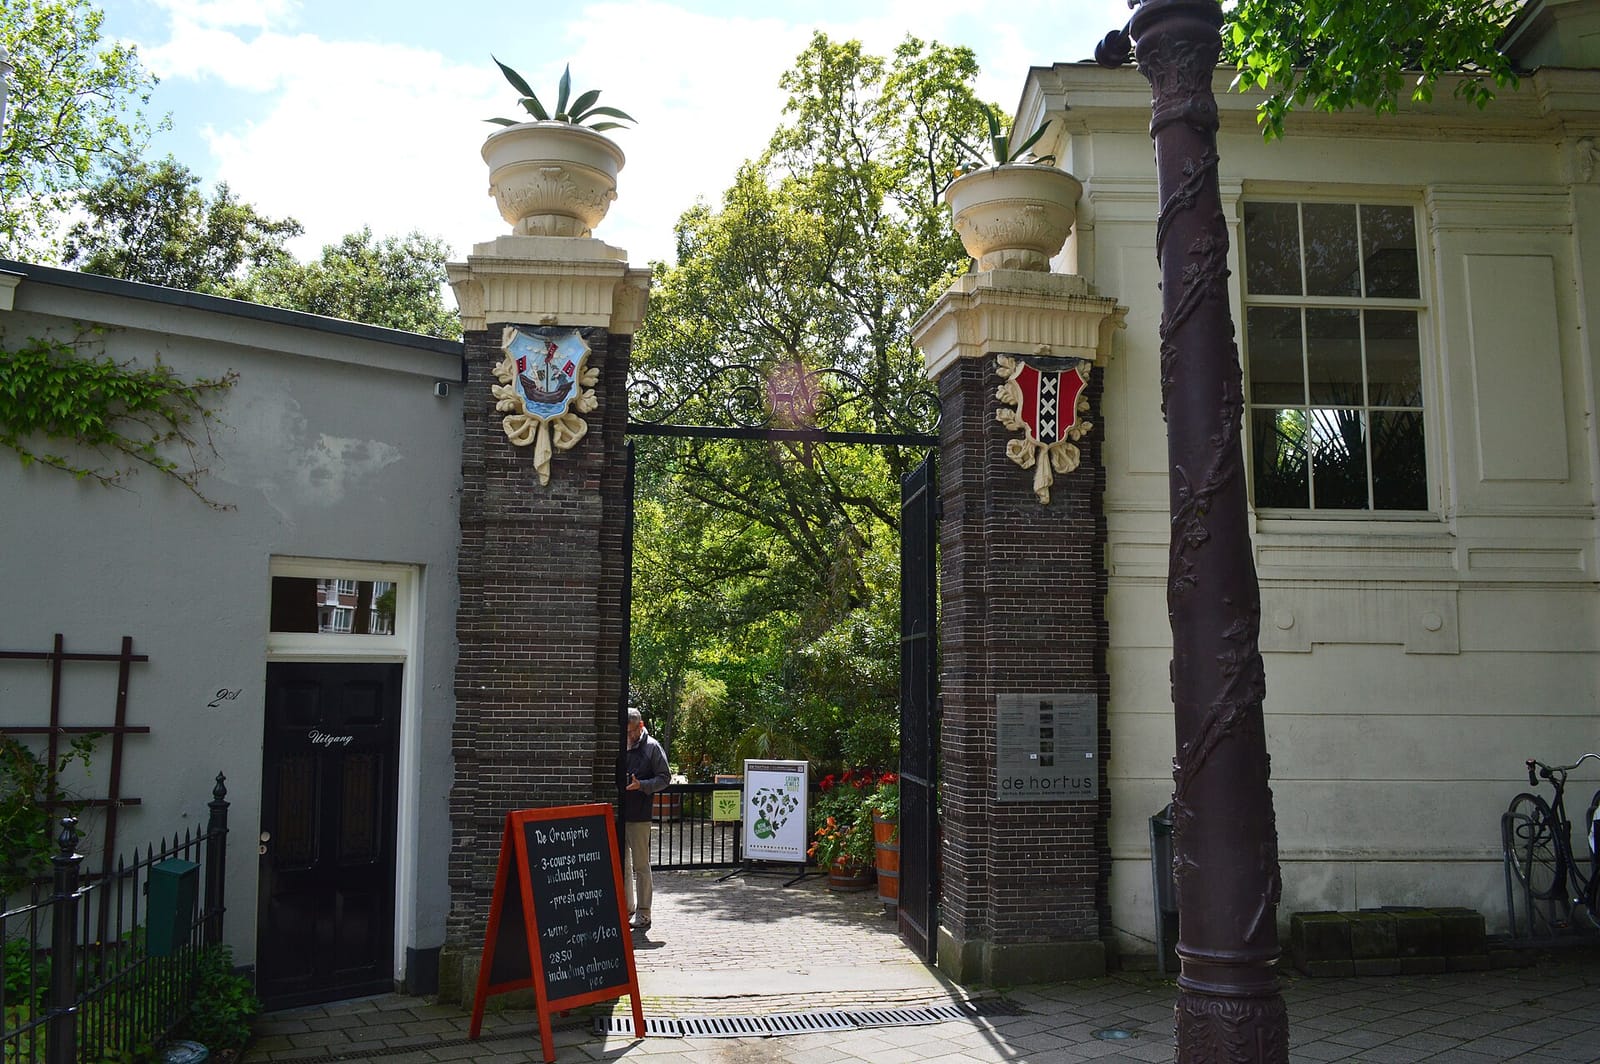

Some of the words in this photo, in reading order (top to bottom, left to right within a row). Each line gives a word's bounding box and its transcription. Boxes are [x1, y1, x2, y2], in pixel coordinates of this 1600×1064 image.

[308, 729, 353, 747] Uitgang
[1001, 776, 1024, 790] de
[1030, 775, 1092, 789] hortus
[535, 829, 547, 844] De
[541, 855, 576, 870] 3-course
